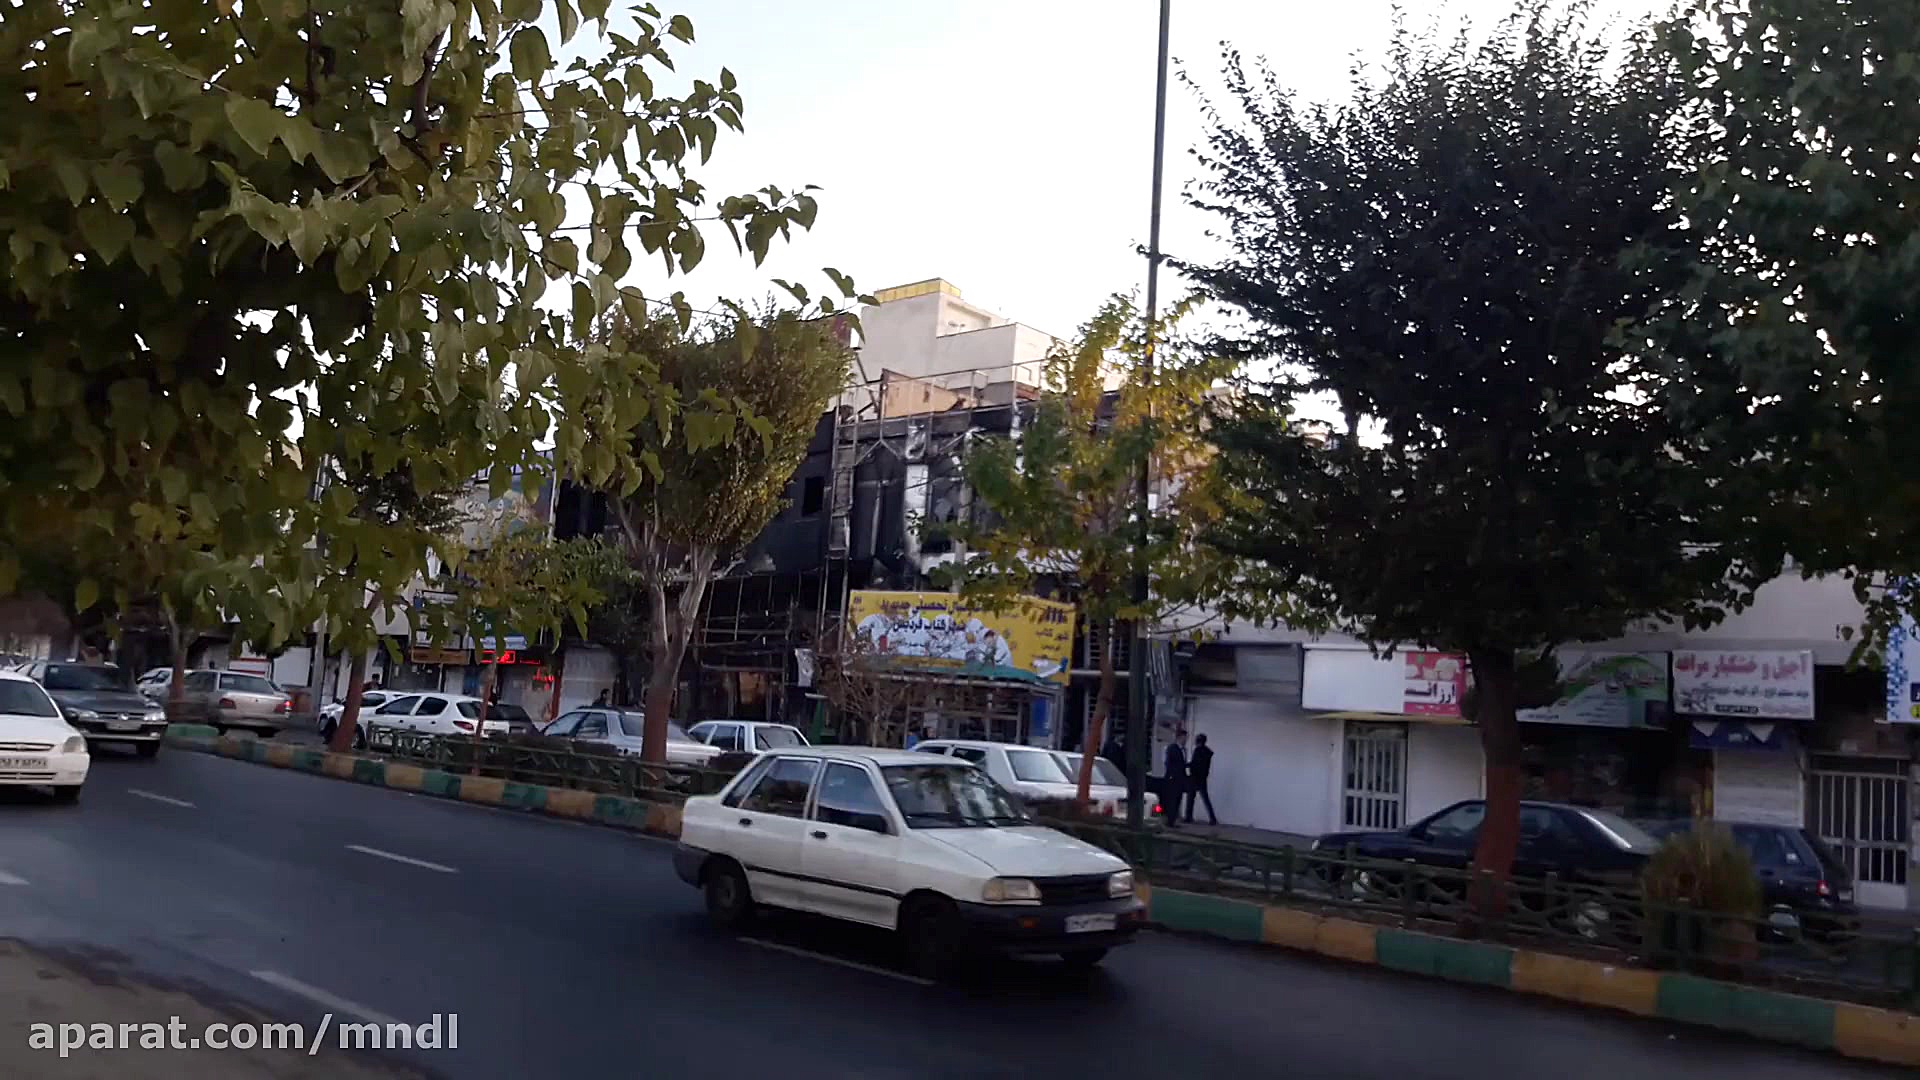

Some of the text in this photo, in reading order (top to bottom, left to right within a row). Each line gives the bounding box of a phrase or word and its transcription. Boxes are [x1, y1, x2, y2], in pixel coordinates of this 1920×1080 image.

[893, 618, 923, 634] فردیس
[923, 618, 946, 630] کتاب
[1711, 653, 1759, 679] خشکبار
[1773, 652, 1808, 681] آجیل
